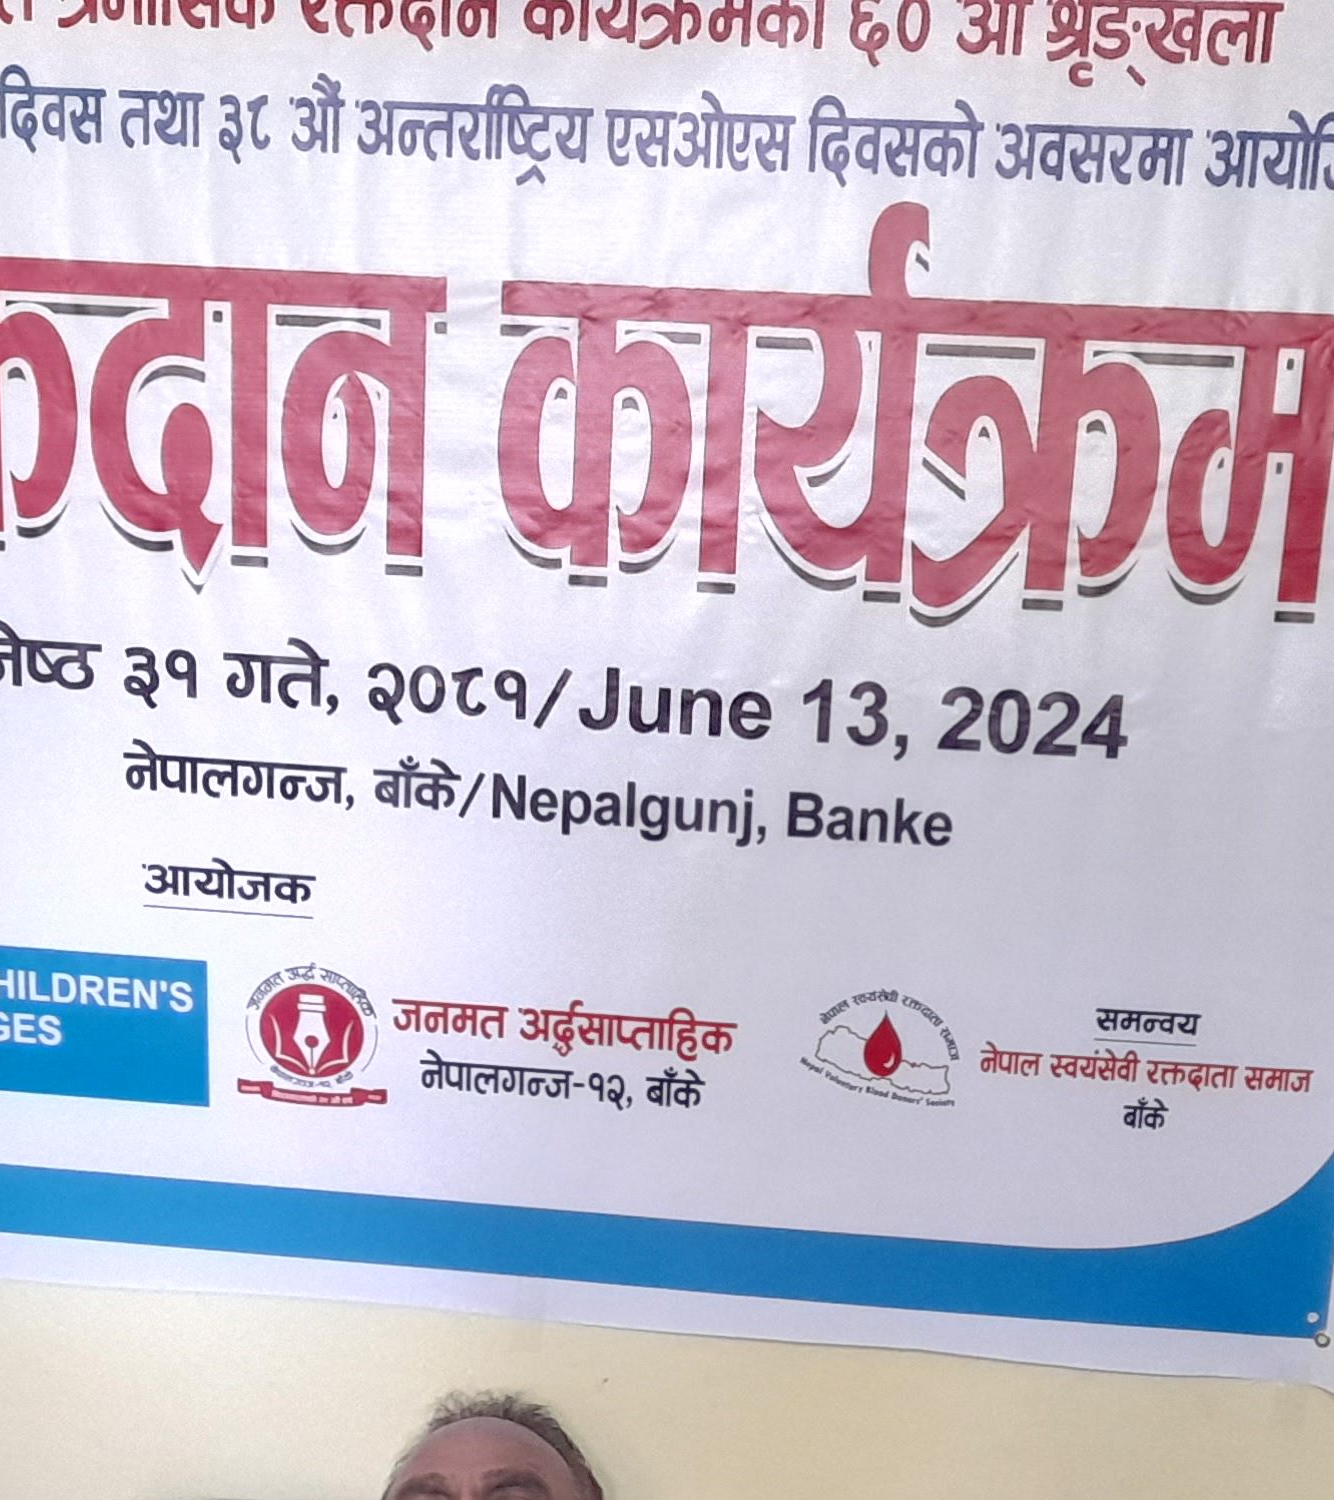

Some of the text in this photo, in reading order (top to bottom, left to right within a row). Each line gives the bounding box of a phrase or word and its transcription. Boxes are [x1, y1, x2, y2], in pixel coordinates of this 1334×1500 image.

[117, 89, 206, 149] तथा
[218, 94, 271, 165] ३८
[604, 89, 797, 173] एसओएस
[808, 94, 986, 188] दिवसको
[994, 122, 1194, 186] अवसरमा
[123, 646, 198, 710] ३१
[222, 637, 339, 716] गते,
[367, 662, 773, 741] २०८१/June
[802, 678, 909, 762] 13,
[936, 686, 1129, 760] 2024
[122, 738, 953, 848] नेपालगन्ज, बाँके/Nepalgunj, Banke
[141, 857, 317, 905] आयोजक
[391, 998, 510, 1040] जनमत
[1095, 1007, 1202, 1036] समन्वय
[645, 1066, 706, 1109] बाँके
[980, 1040, 1044, 1077] नेपाल
[1146, 1059, 1239, 1092] रक्तदाता
[1244, 1066, 1315, 1093] समाज
[1123, 1097, 1170, 1130] बाँके
